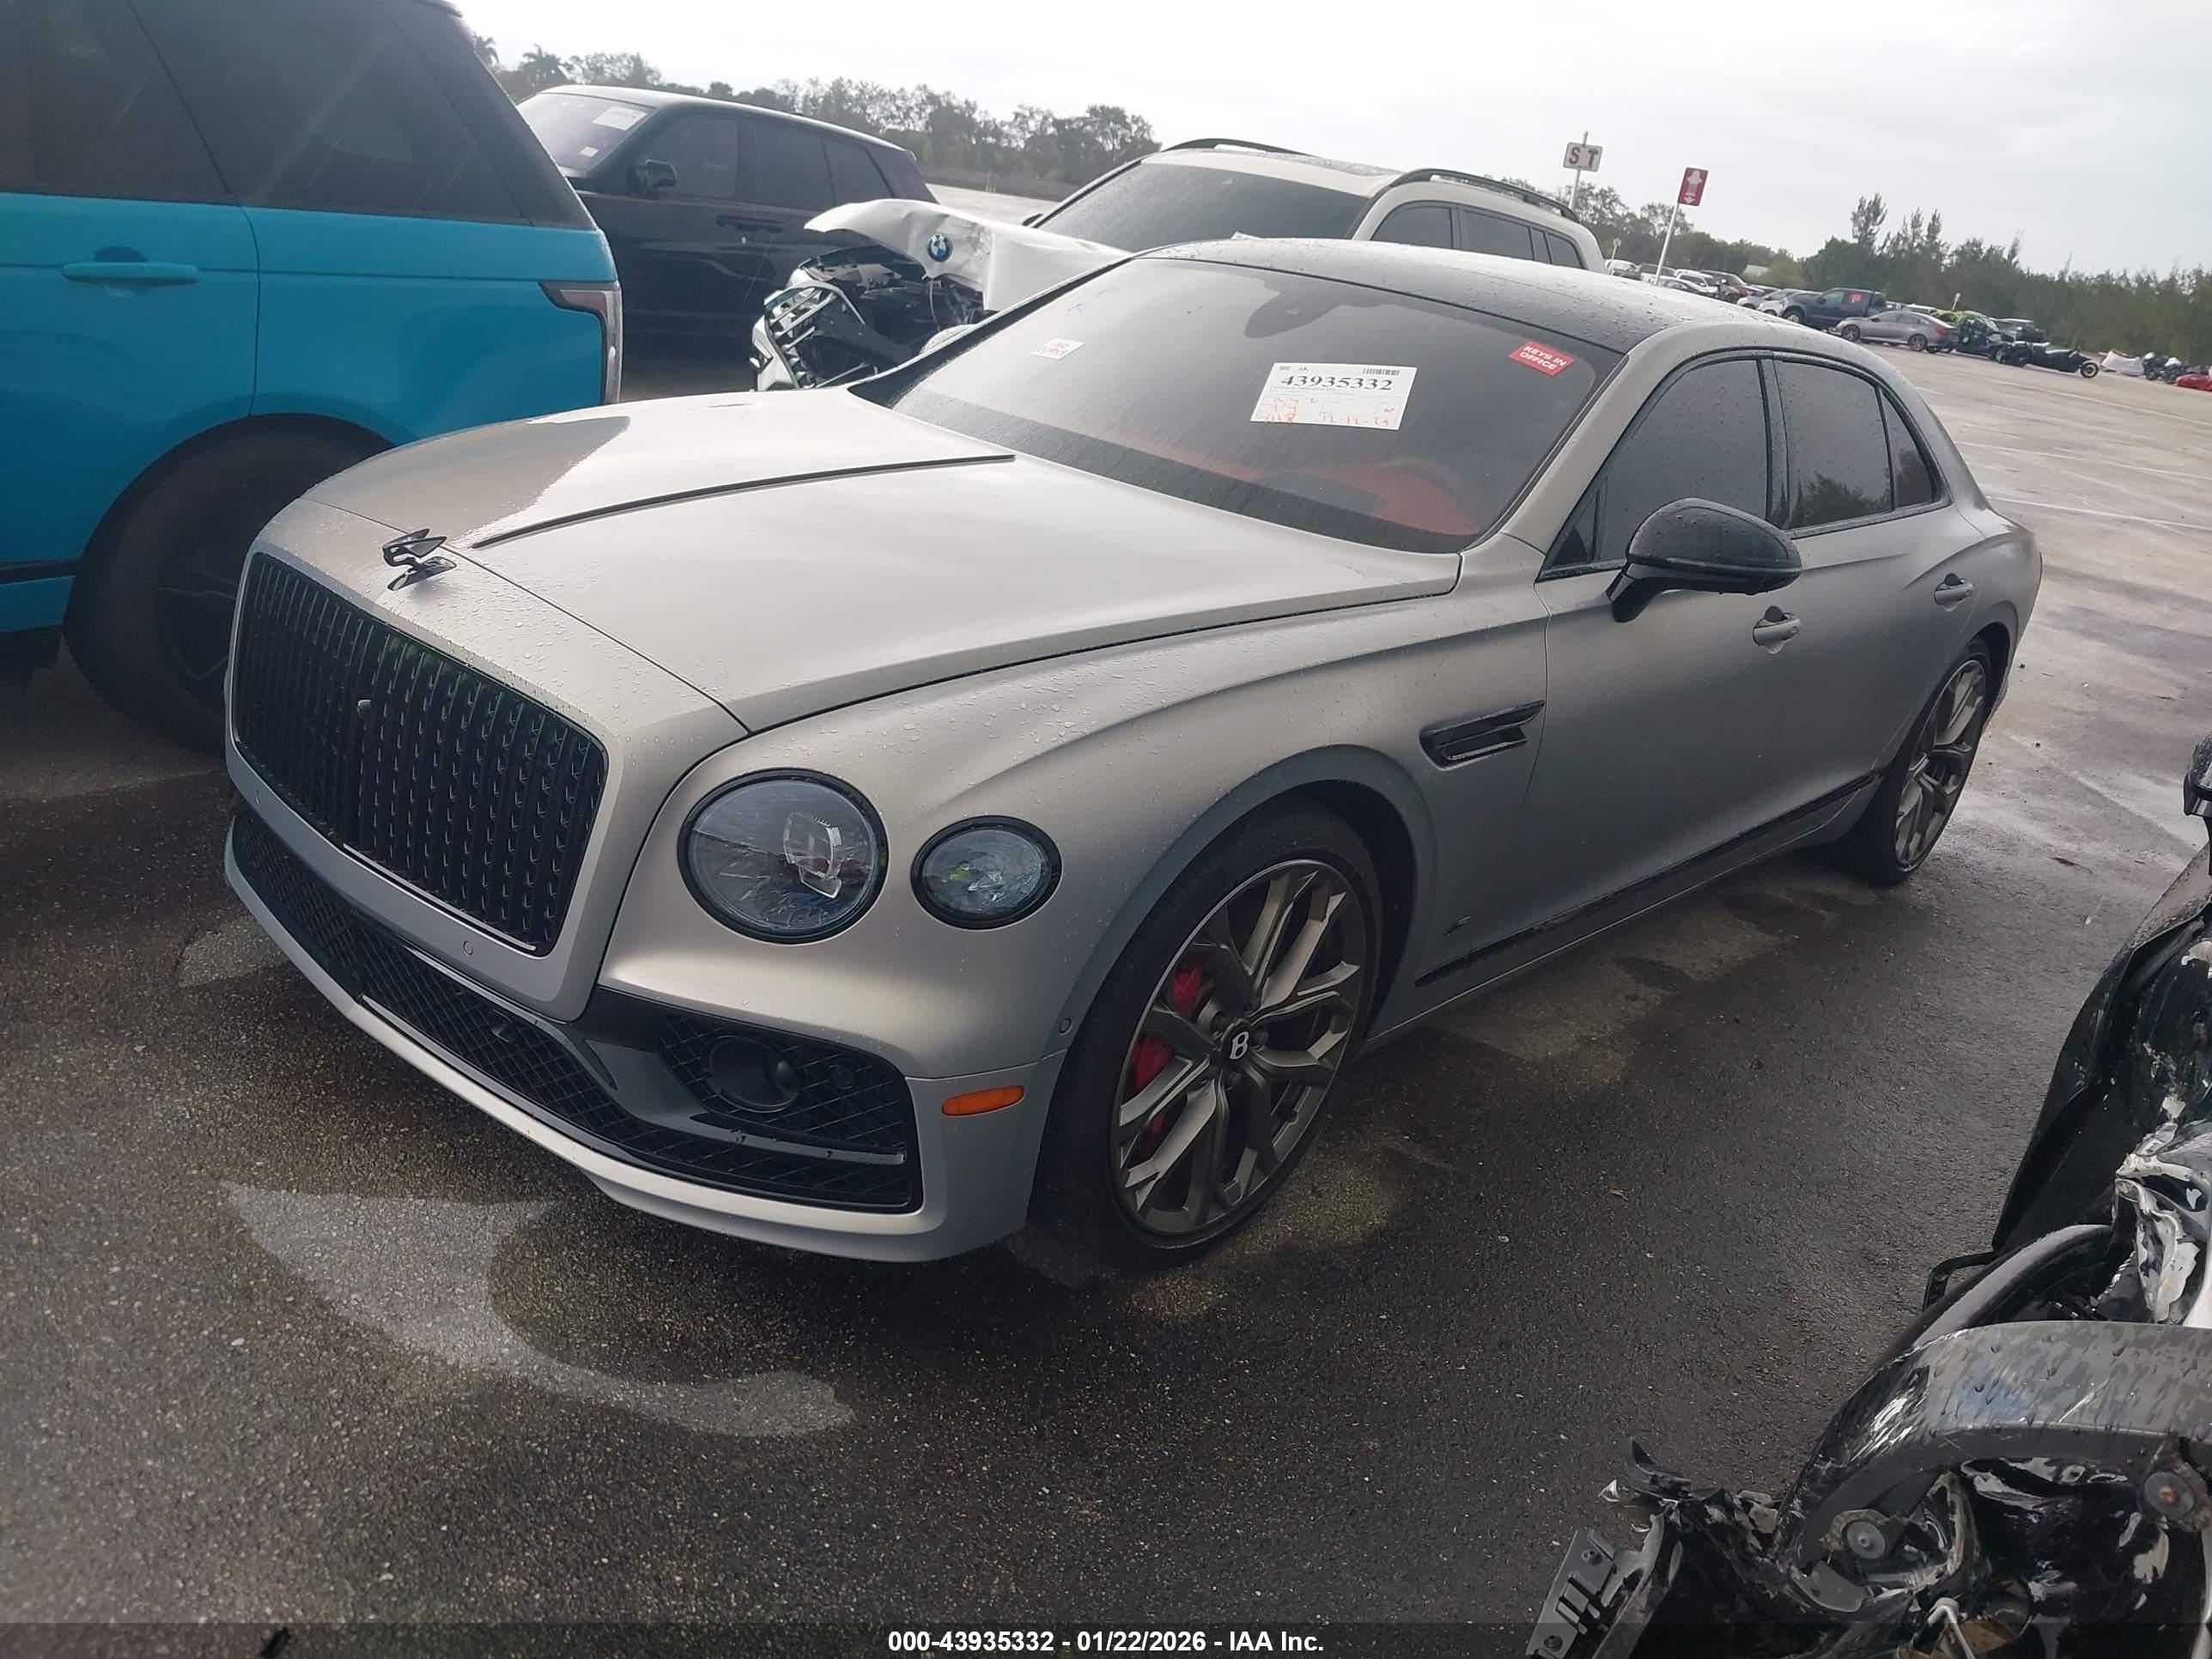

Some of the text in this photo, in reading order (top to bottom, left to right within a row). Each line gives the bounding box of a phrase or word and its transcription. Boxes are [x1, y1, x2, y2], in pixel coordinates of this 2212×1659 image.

[1519, 351, 1558, 370] OFFICE
[1523, 346, 1567, 367] KEYS IN
[1280, 375, 1393, 391] 43935332
